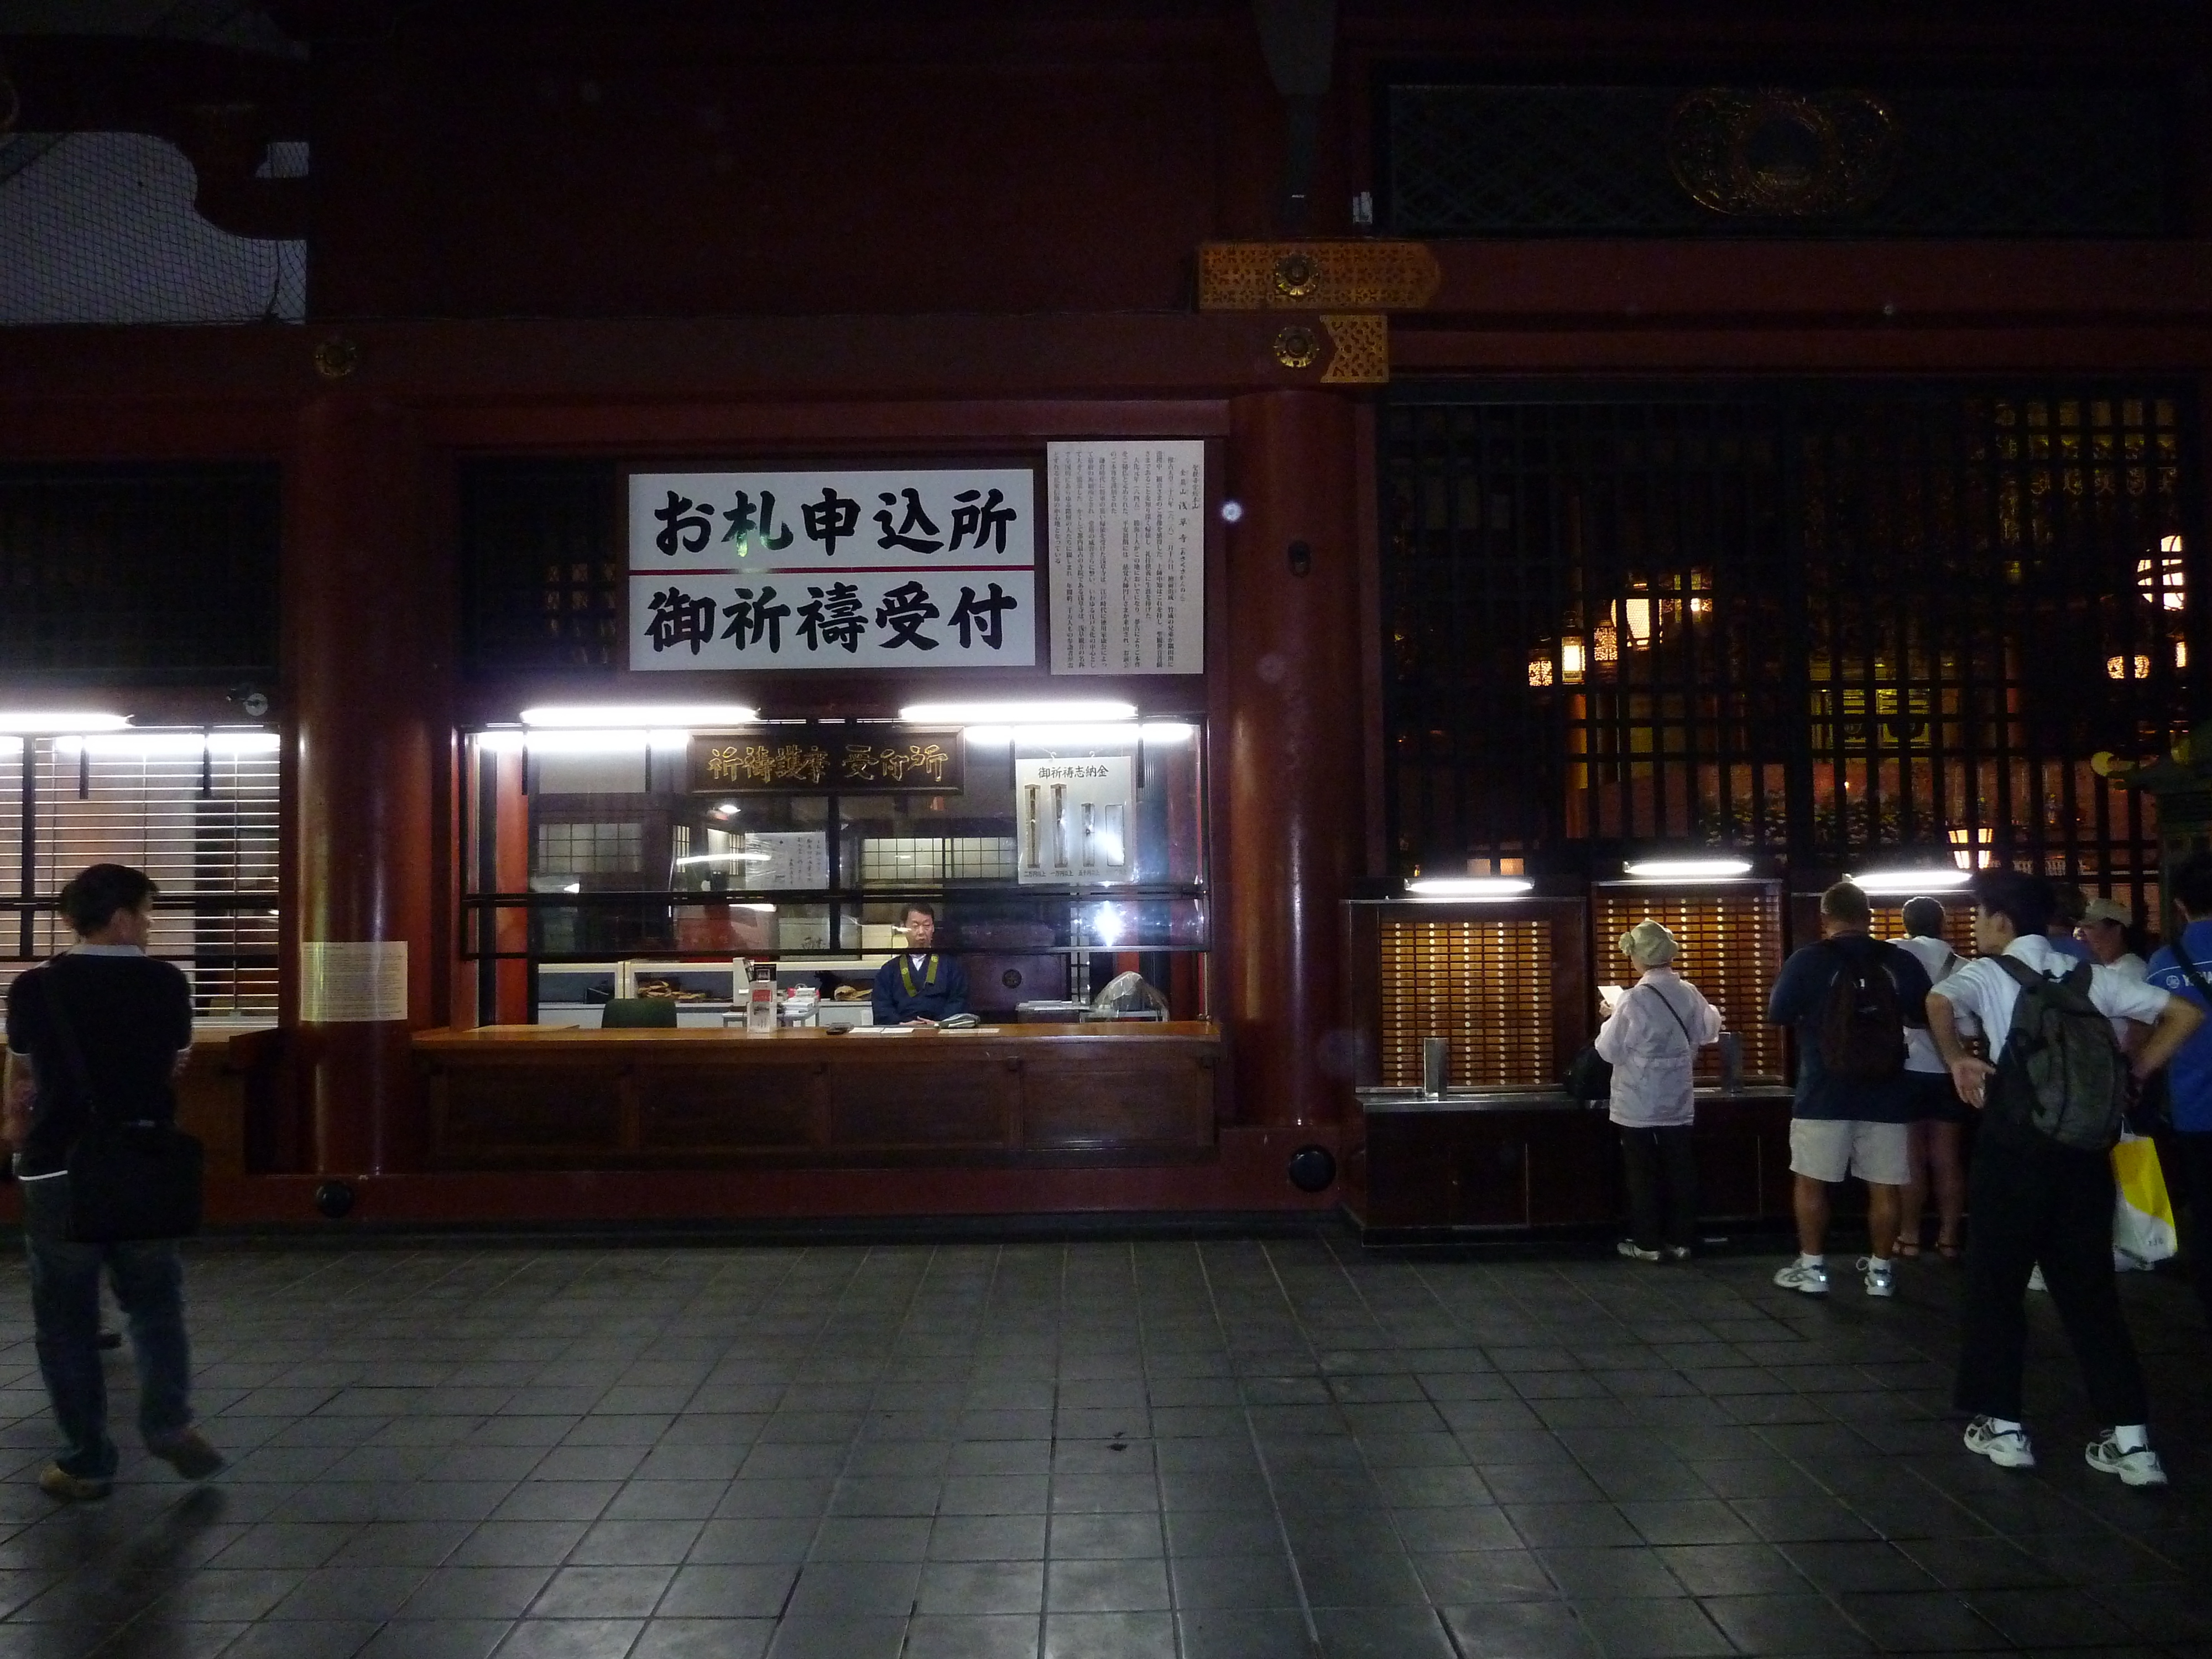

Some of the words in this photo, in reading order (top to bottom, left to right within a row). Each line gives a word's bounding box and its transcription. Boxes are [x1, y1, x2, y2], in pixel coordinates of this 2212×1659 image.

[654, 487, 1017, 556] お札申込所
